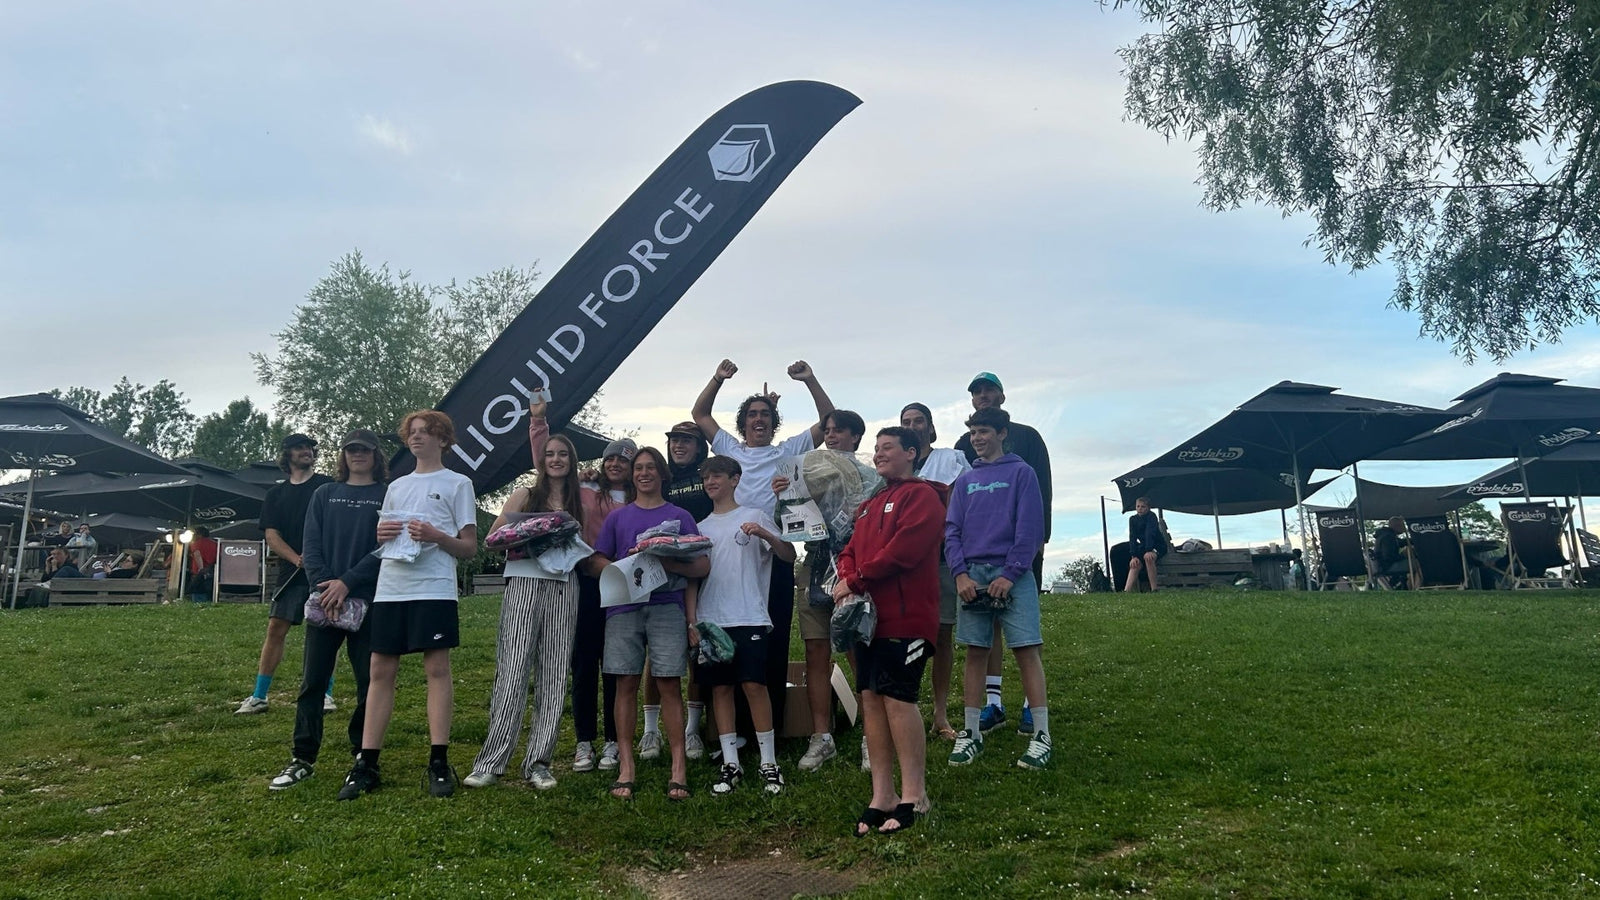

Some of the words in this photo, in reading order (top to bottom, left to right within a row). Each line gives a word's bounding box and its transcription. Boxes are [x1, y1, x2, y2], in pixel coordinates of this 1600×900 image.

[451, 323, 586, 471] LIQUID
[578, 186, 715, 329] FORCE
[1320, 515, 1355, 529] Carlsberg
[1508, 509, 1546, 523] Carlsberg
[1410, 521, 1446, 534] Carlsberg
[224, 546, 257, 557] Carlsberg
